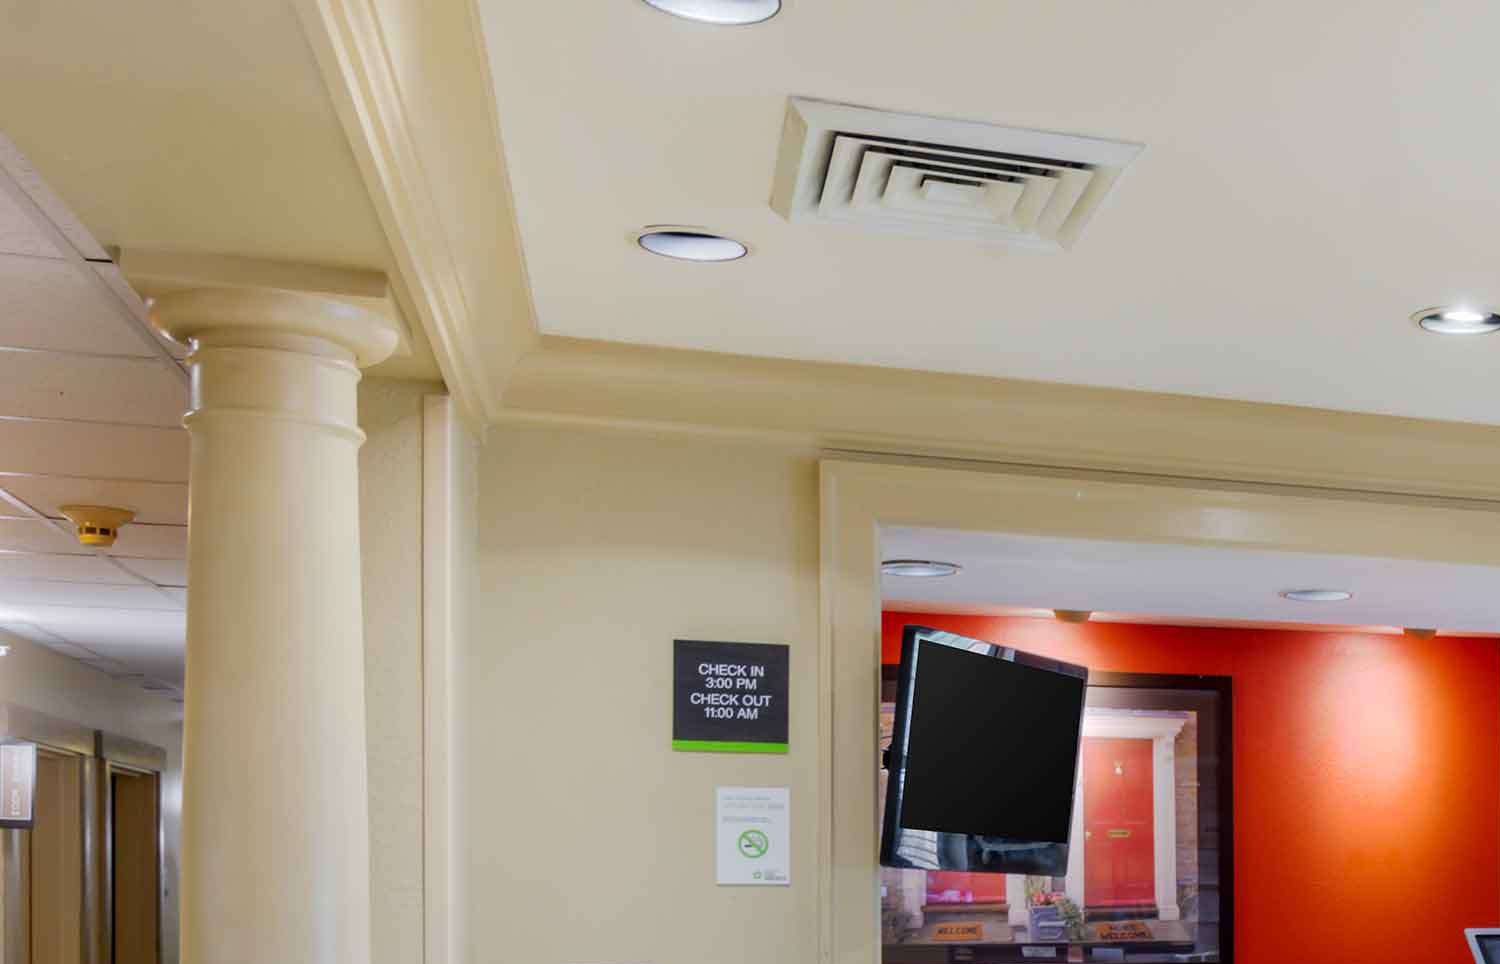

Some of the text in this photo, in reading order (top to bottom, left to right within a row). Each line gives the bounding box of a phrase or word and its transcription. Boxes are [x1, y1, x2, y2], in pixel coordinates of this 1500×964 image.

[698, 663, 765, 677] CHECK IN
[705, 677, 757, 690] 3:00 PM
[690, 692, 773, 707] CHECK OUT
[704, 706, 759, 720] 11:00 AM
